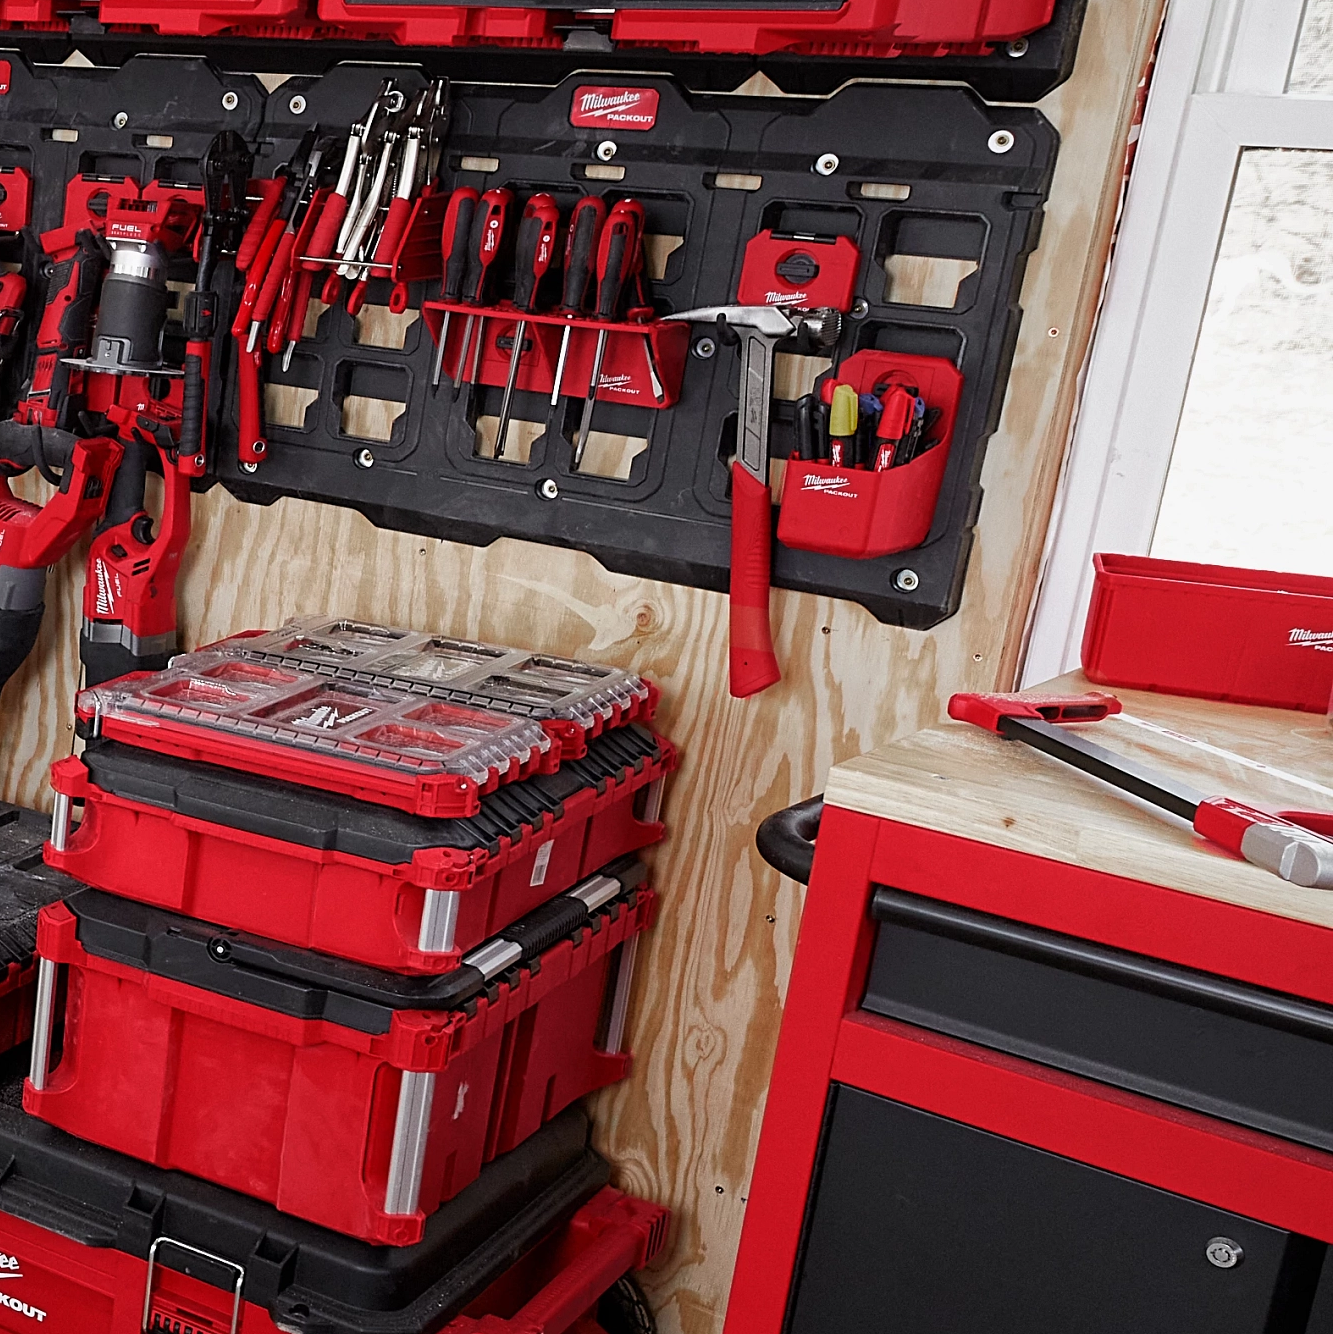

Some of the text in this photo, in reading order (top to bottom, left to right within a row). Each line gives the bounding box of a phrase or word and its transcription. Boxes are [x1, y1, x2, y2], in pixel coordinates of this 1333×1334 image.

[579, 91, 641, 112] Milwaukee
[606, 114, 654, 123] PACKOUT
[111, 224, 142, 233] FUEL
[765, 291, 808, 304] Milwaukee
[803, 474, 848, 487] Milwaukee
[823, 489, 858, 498] PACKOUT
[95, 558, 110, 615] Milwaukee
[114, 572, 123, 598] FUEL
